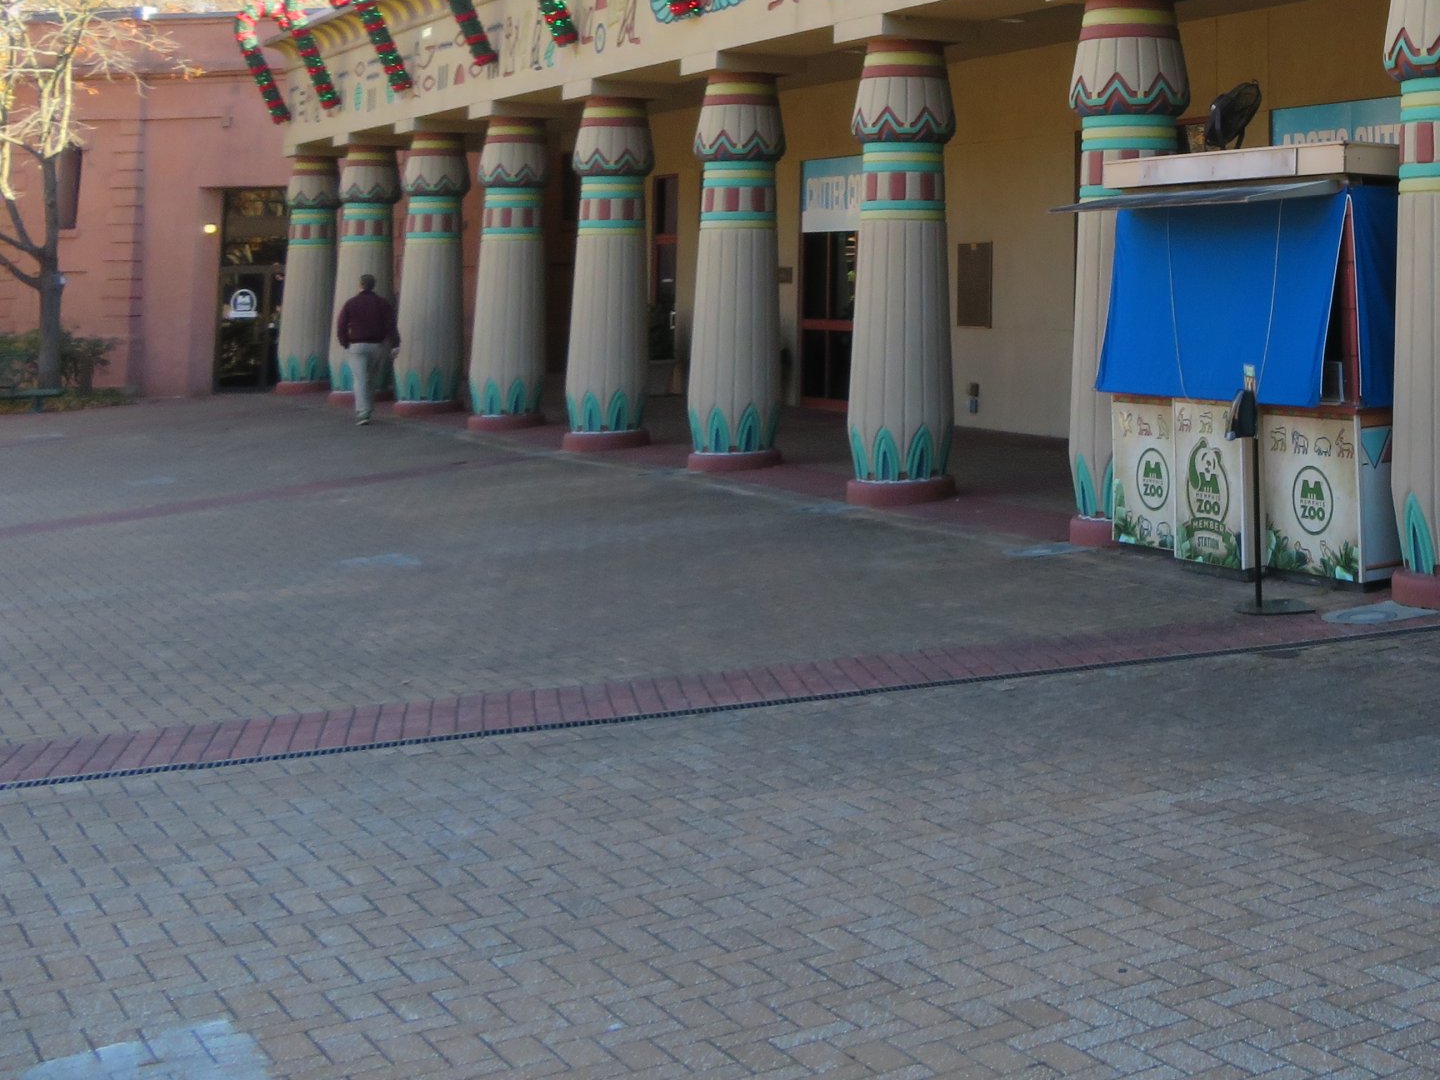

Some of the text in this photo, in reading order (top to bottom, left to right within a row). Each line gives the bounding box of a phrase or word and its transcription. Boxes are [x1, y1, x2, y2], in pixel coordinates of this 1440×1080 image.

[1143, 483, 1163, 498] ZOO
[1196, 498, 1220, 516] ZOO
[1300, 504, 1325, 521] ZOO
[1192, 520, 1225, 532] MEMBER
